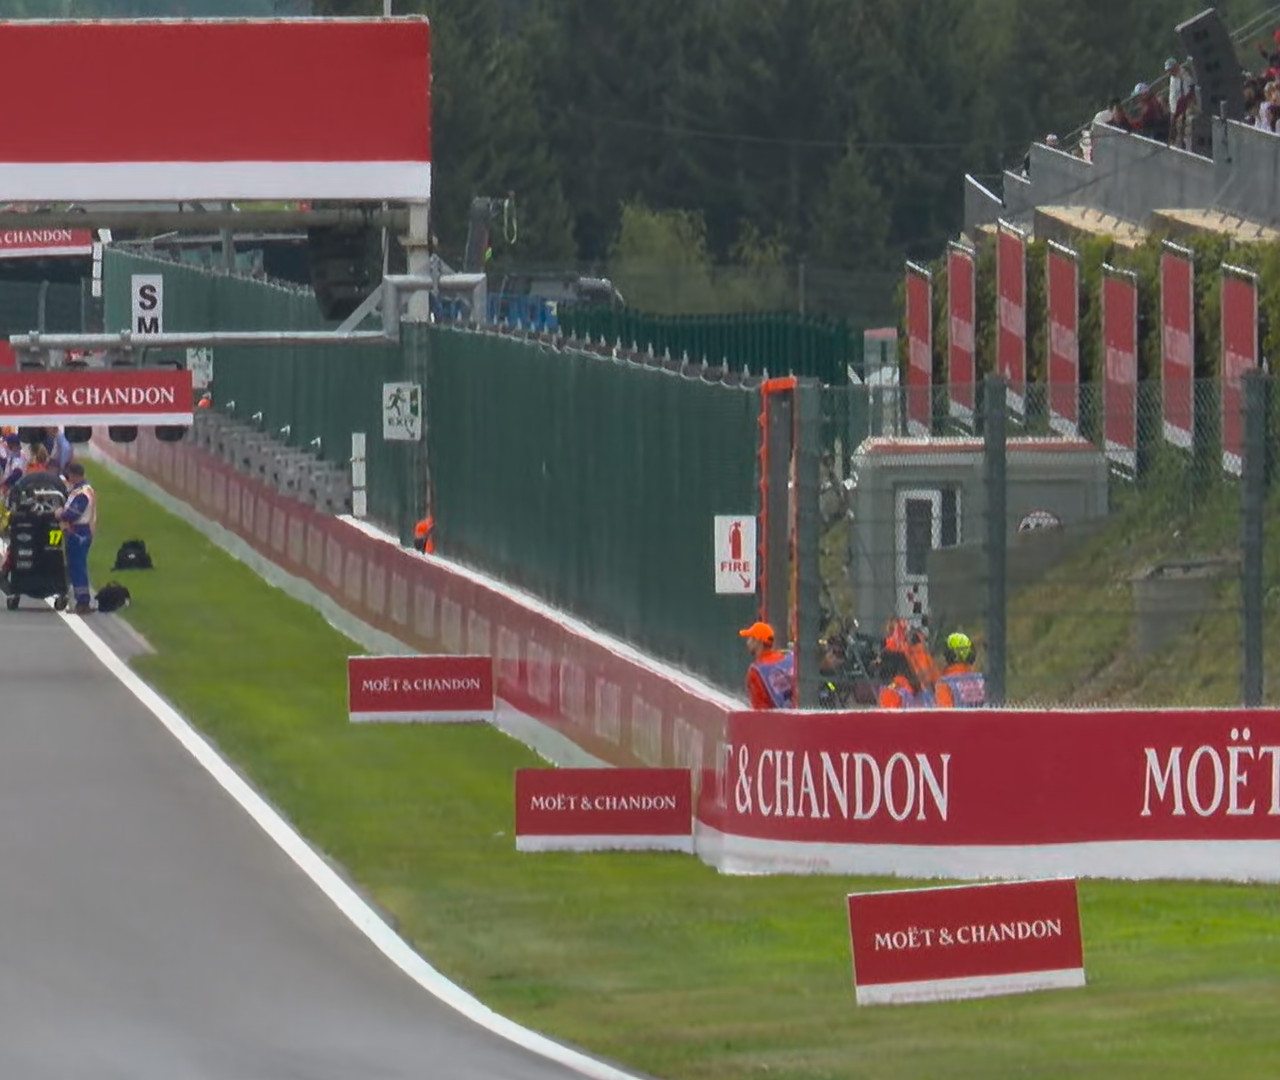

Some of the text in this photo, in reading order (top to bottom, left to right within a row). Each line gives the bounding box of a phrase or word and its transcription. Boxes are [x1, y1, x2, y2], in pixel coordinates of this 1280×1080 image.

[4, 229, 73, 244] CHANDON
[139, 284, 157, 311] S
[55, 387, 69, 405] &
[72, 386, 174, 405] CHANDON
[721, 561, 750, 573] FIRE
[362, 677, 480, 692] MOËT & CHANDON
[735, 744, 752, 816] &
[757, 749, 951, 821] CHANDON
[530, 793, 677, 811] MOËT & CHANDON
[875, 919, 1062, 951] MOËT & CHANDON
